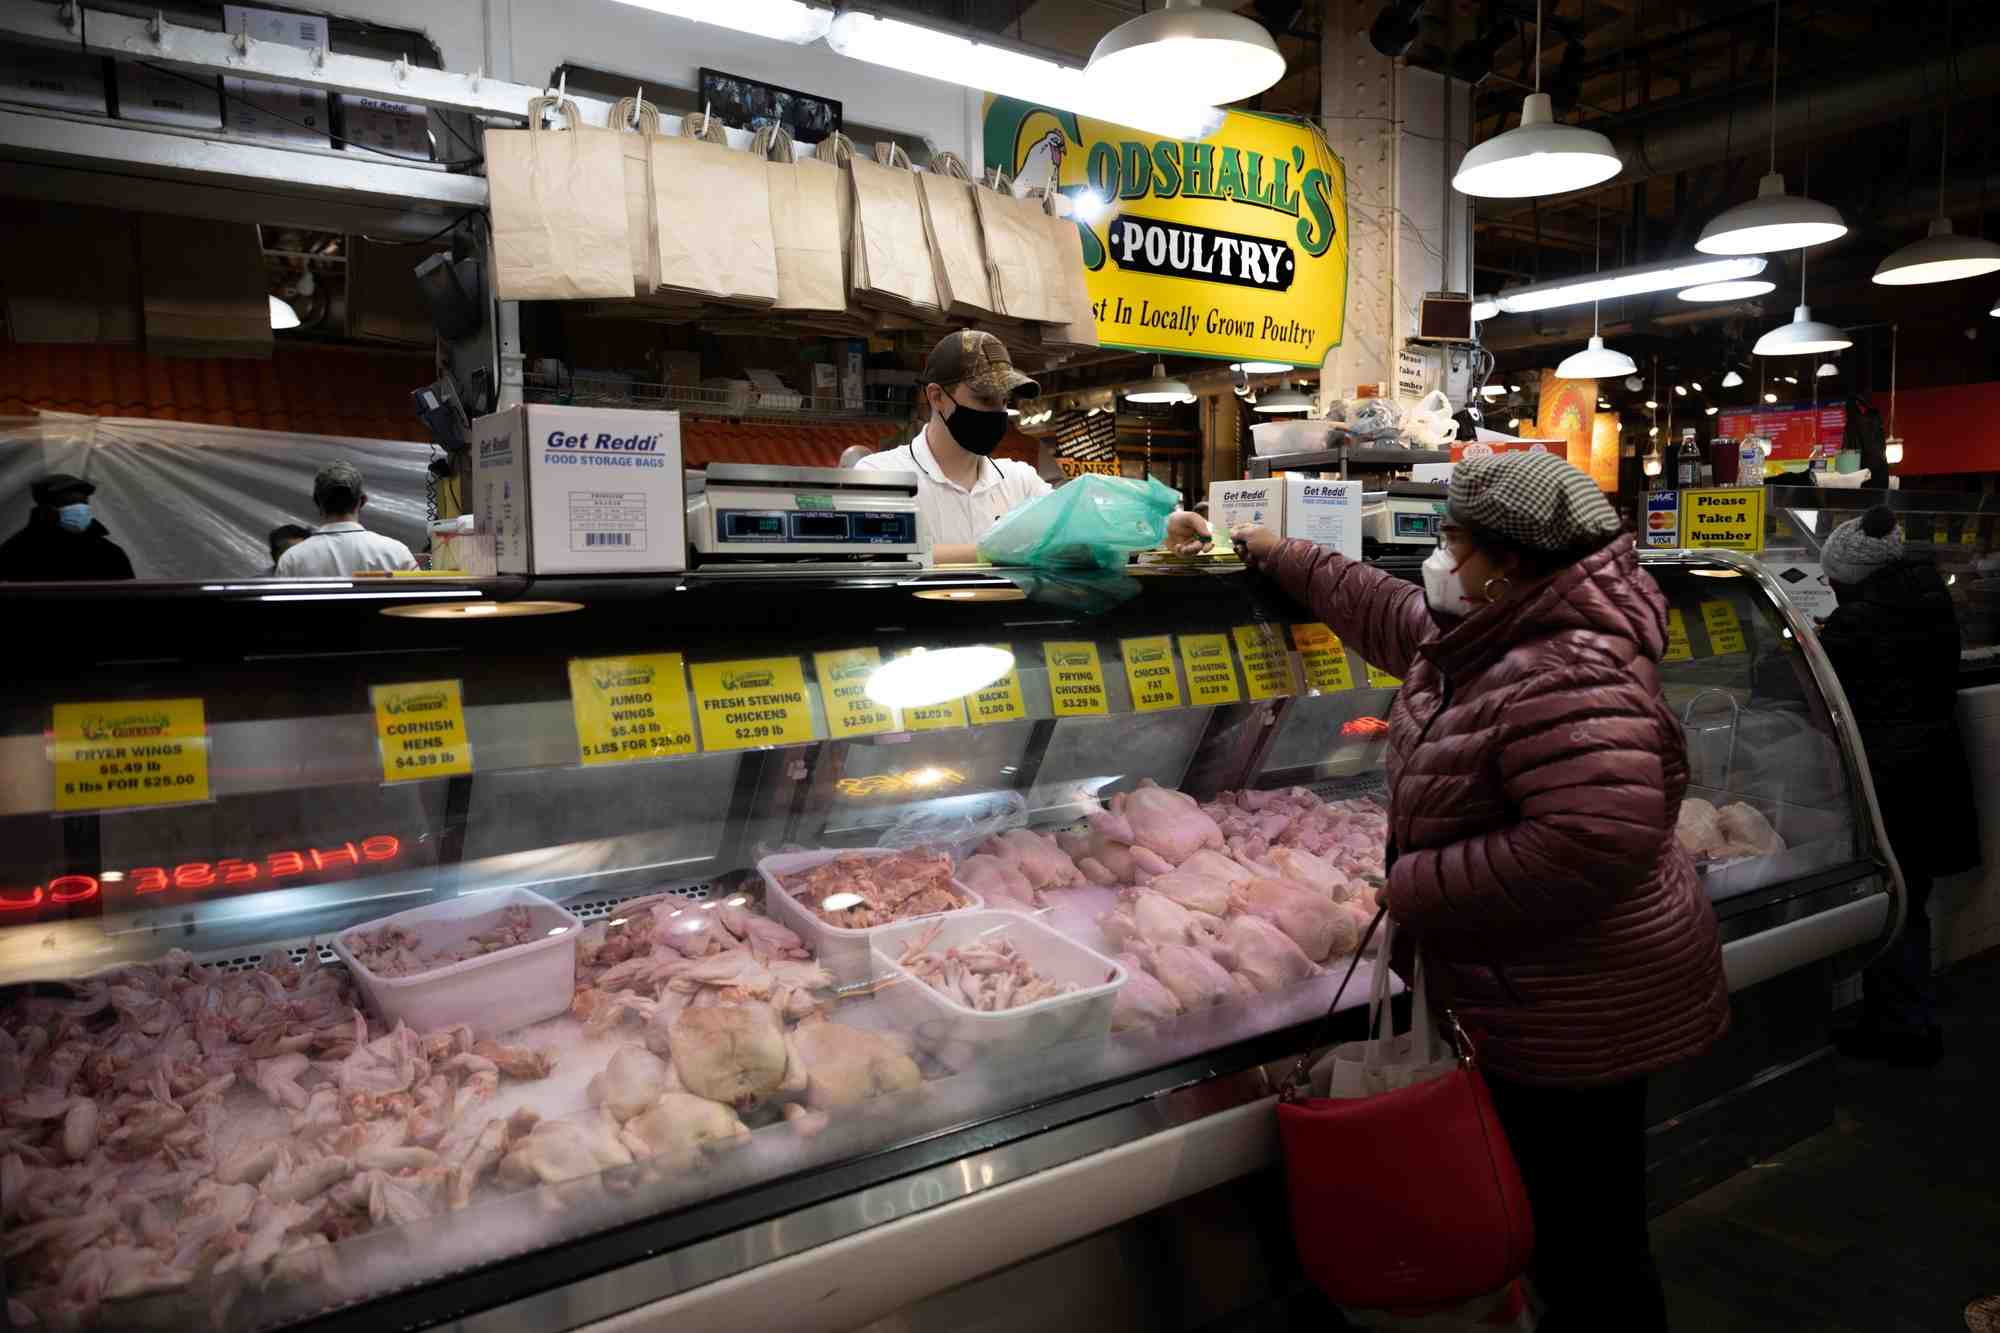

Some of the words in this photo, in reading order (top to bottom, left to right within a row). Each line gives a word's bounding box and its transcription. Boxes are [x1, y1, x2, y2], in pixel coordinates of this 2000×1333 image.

[1123, 221, 1285, 283] POULTRY
[1113, 296, 1132, 325] In
[1140, 300, 1199, 336] Locally
[1206, 308, 1254, 338] Grown
[1262, 315, 1316, 349] Poultry
[1399, 381, 1423, 391] umber
[547, 431, 588, 449] Get
[595, 433, 658, 451] Reddi
[544, 454, 578, 465] FOOD
[580, 455, 633, 467] STORAGE
[635, 457, 665, 468] BAGS
[1224, 491, 1239, 501] Get
[1304, 486, 1319, 496] Get
[1321, 486, 1346, 497] Reddi
[1697, 496, 1747, 506] Please
[1697, 513, 1732, 523] Take
[1736, 513, 1746, 522] A
[1691, 531, 1752, 540] Number
[1059, 671, 1093, 680] FRYING
[1134, 667, 1170, 678] CHICKEN
[1056, 685, 1101, 695] CHICKENS
[1148, 680, 1162, 689] FAT
[609, 693, 652, 707] JUMBO
[704, 697, 746, 710] FRESH
[748, 692, 802, 707] STEWING
[612, 708, 655, 721] WINGS
[726, 708, 787, 724] CHICKENS
[386, 719, 454, 736] CORNISH
[735, 727, 769, 739] $2.99
[772, 725, 783, 736] lb
[403, 736, 443, 751] HENS
[583, 745, 591, 756] 5
[594, 741, 618, 755] LBS
[622, 738, 647, 751] FOR
[650, 734, 691, 749] $25.00
[75, 747, 126, 761] FRYER
[131, 744, 183, 757] WINGS
[147, 761, 161, 772] lb
[395, 754, 437, 768] $4.99
[441, 752, 455, 763] lb
[80, 781, 102, 793] lbs
[107, 778, 138, 791] FOR
